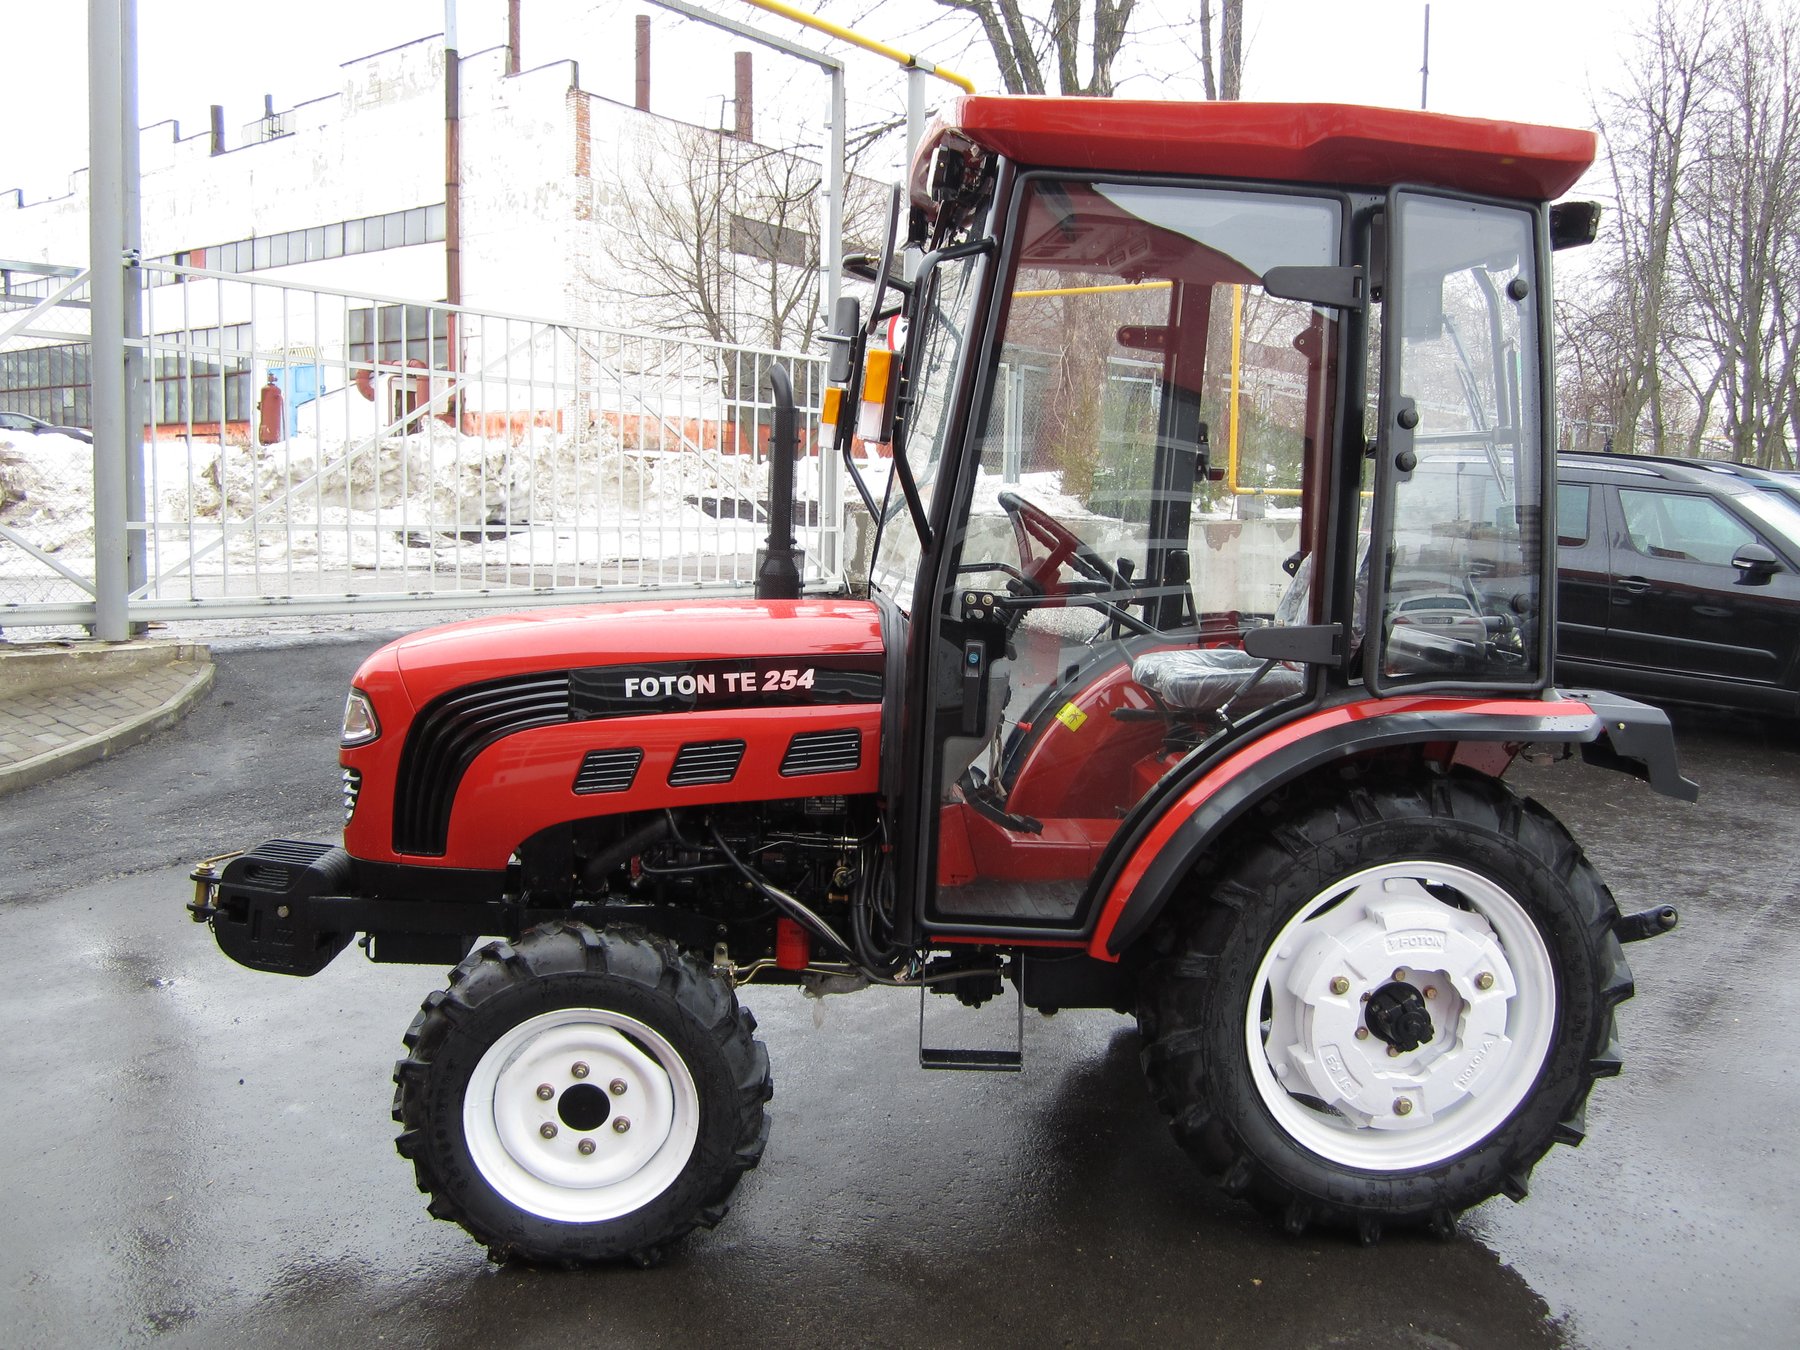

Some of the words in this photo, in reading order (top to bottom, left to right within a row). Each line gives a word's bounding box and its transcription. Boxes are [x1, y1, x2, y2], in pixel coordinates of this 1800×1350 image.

[625, 674, 716, 697] FOTON
[723, 672, 757, 692] TE
[761, 668, 815, 691] 254
[1399, 935, 1442, 948] FOTON
